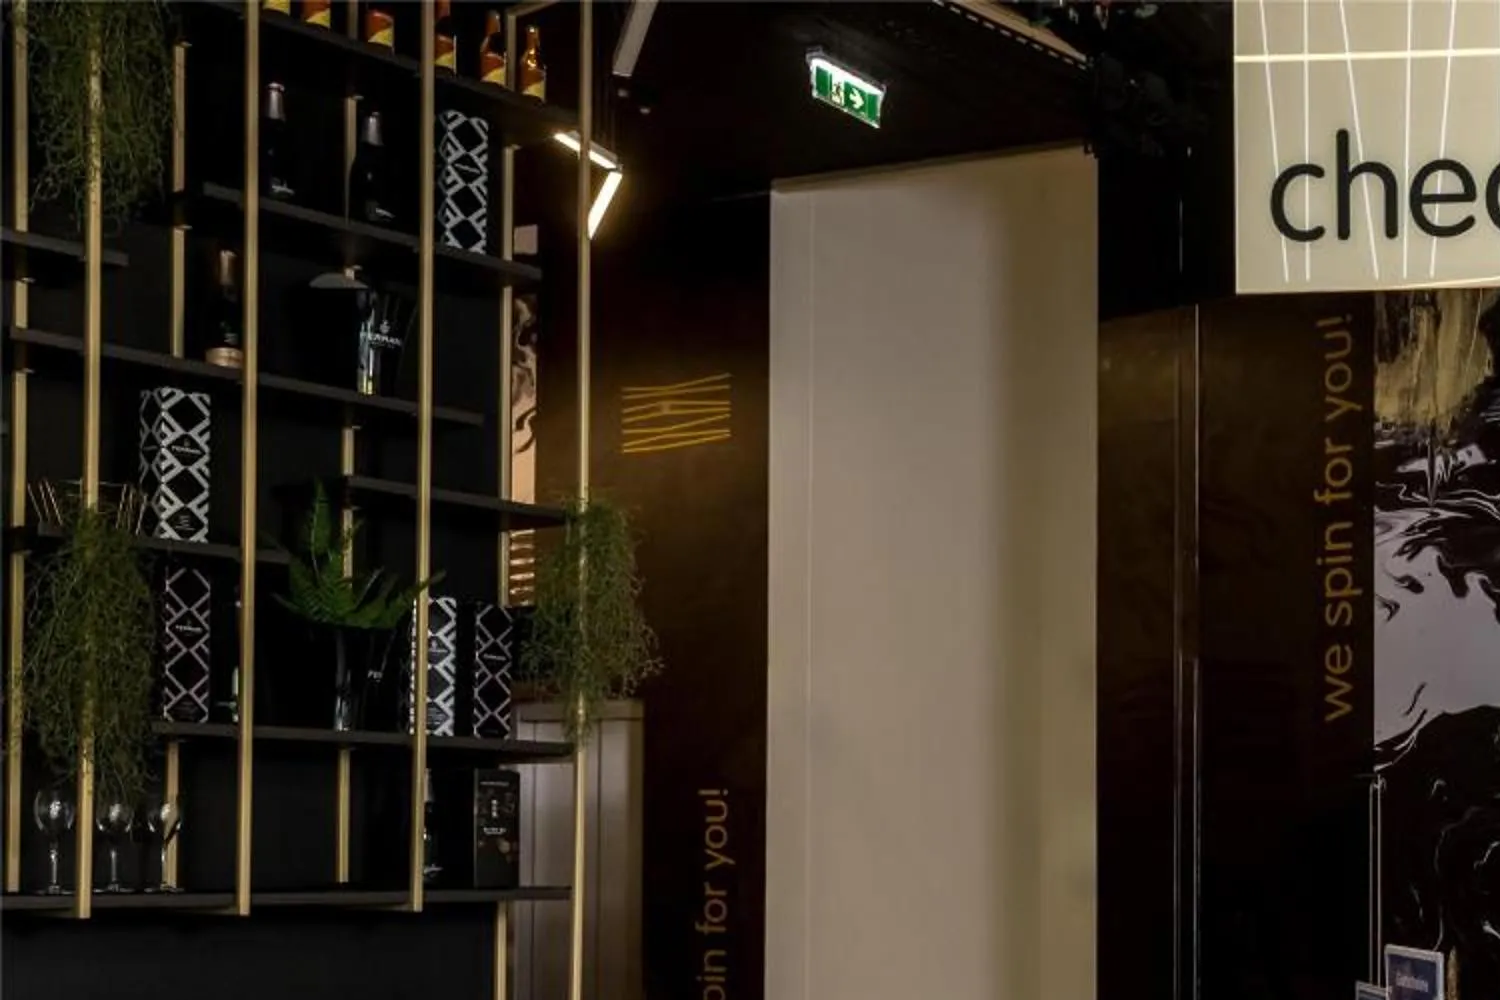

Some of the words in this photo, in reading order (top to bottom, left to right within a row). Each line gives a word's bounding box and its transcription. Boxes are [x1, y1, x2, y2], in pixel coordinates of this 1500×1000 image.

[1315, 312, 1363, 423] you!
[1313, 437, 1354, 504] for
[1316, 520, 1363, 627] spin
[1324, 643, 1354, 722] we
[698, 787, 736, 871] you!
[694, 881, 728, 935] for
